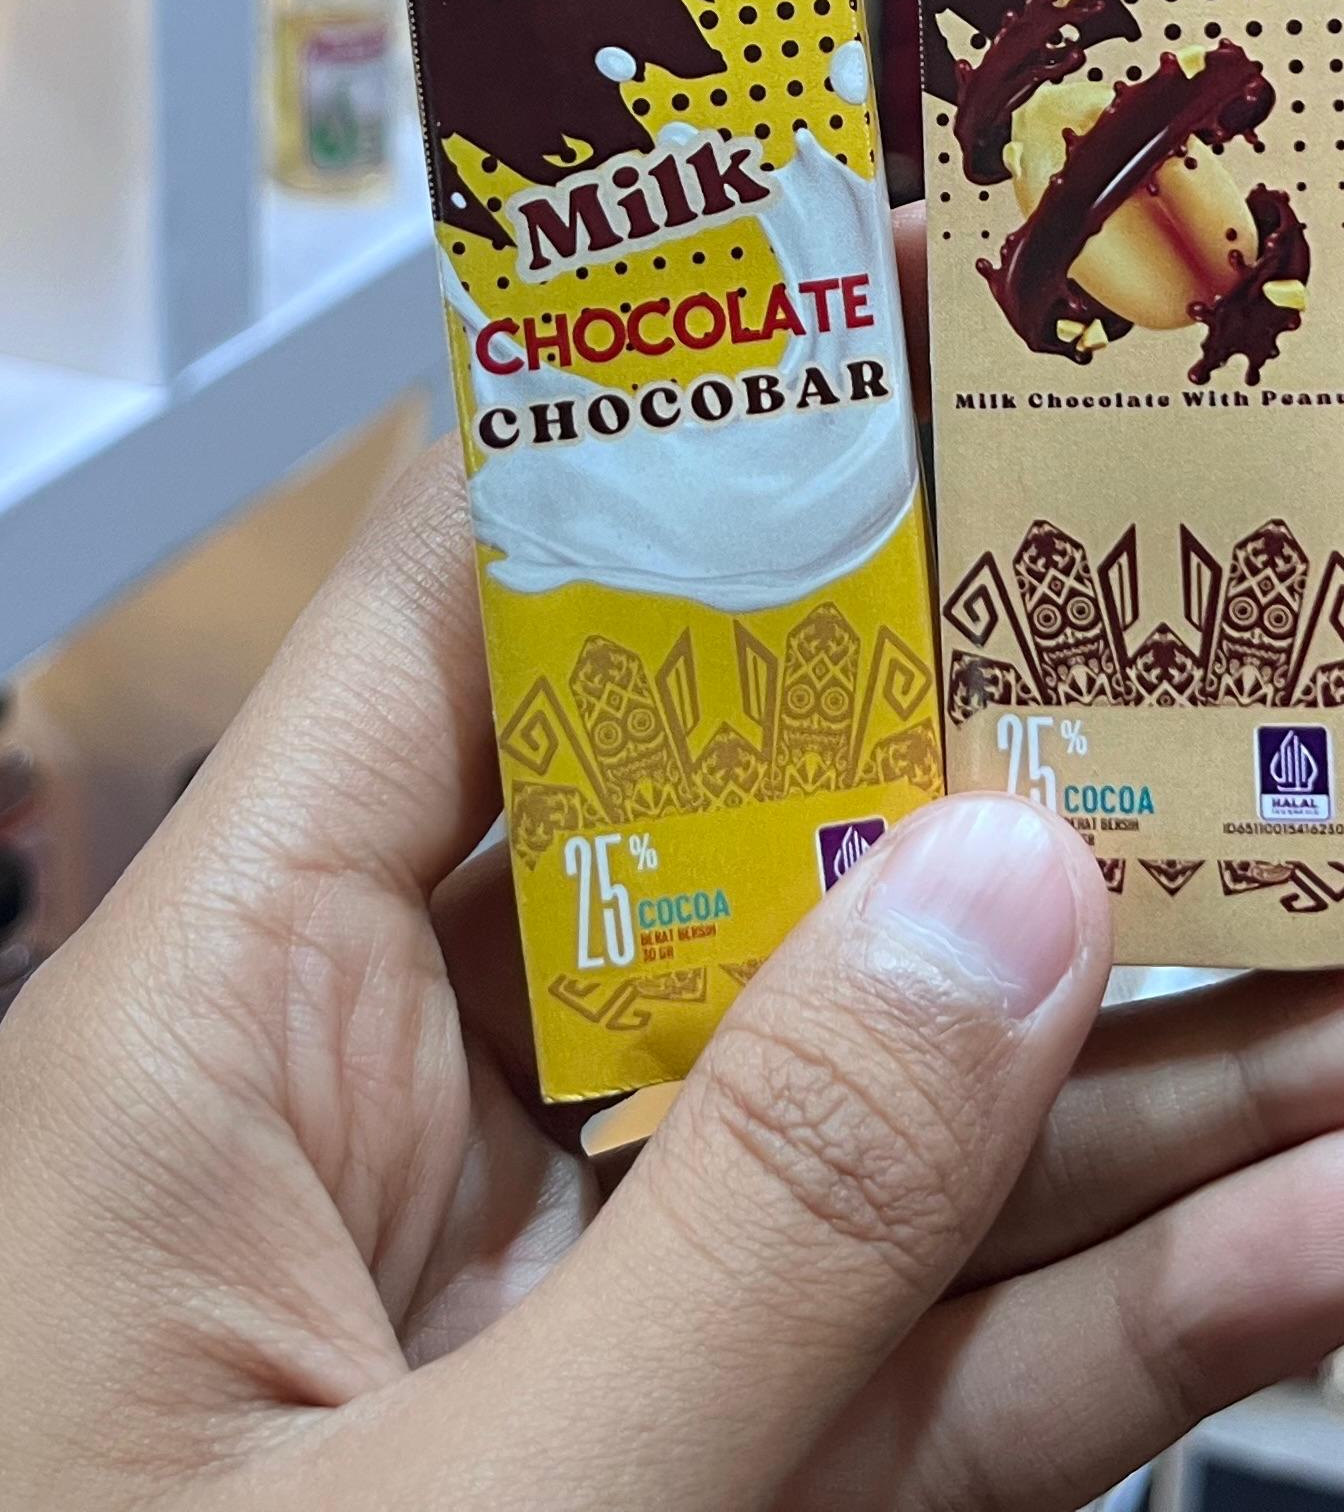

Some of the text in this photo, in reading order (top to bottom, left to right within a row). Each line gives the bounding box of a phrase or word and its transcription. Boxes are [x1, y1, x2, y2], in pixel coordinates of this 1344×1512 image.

[518, 140, 771, 272] Milk
[475, 273, 875, 376] CHOCOLATE
[478, 359, 890, 450] CHOCOBAR
[955, 391, 1018, 410] Milk
[1027, 391, 1170, 409] Chocolate
[1181, 390, 1250, 408] With
[1064, 785, 1155, 816] COCOA
[1271, 797, 1320, 810] HALAL
[638, 889, 731, 930] COCOA
